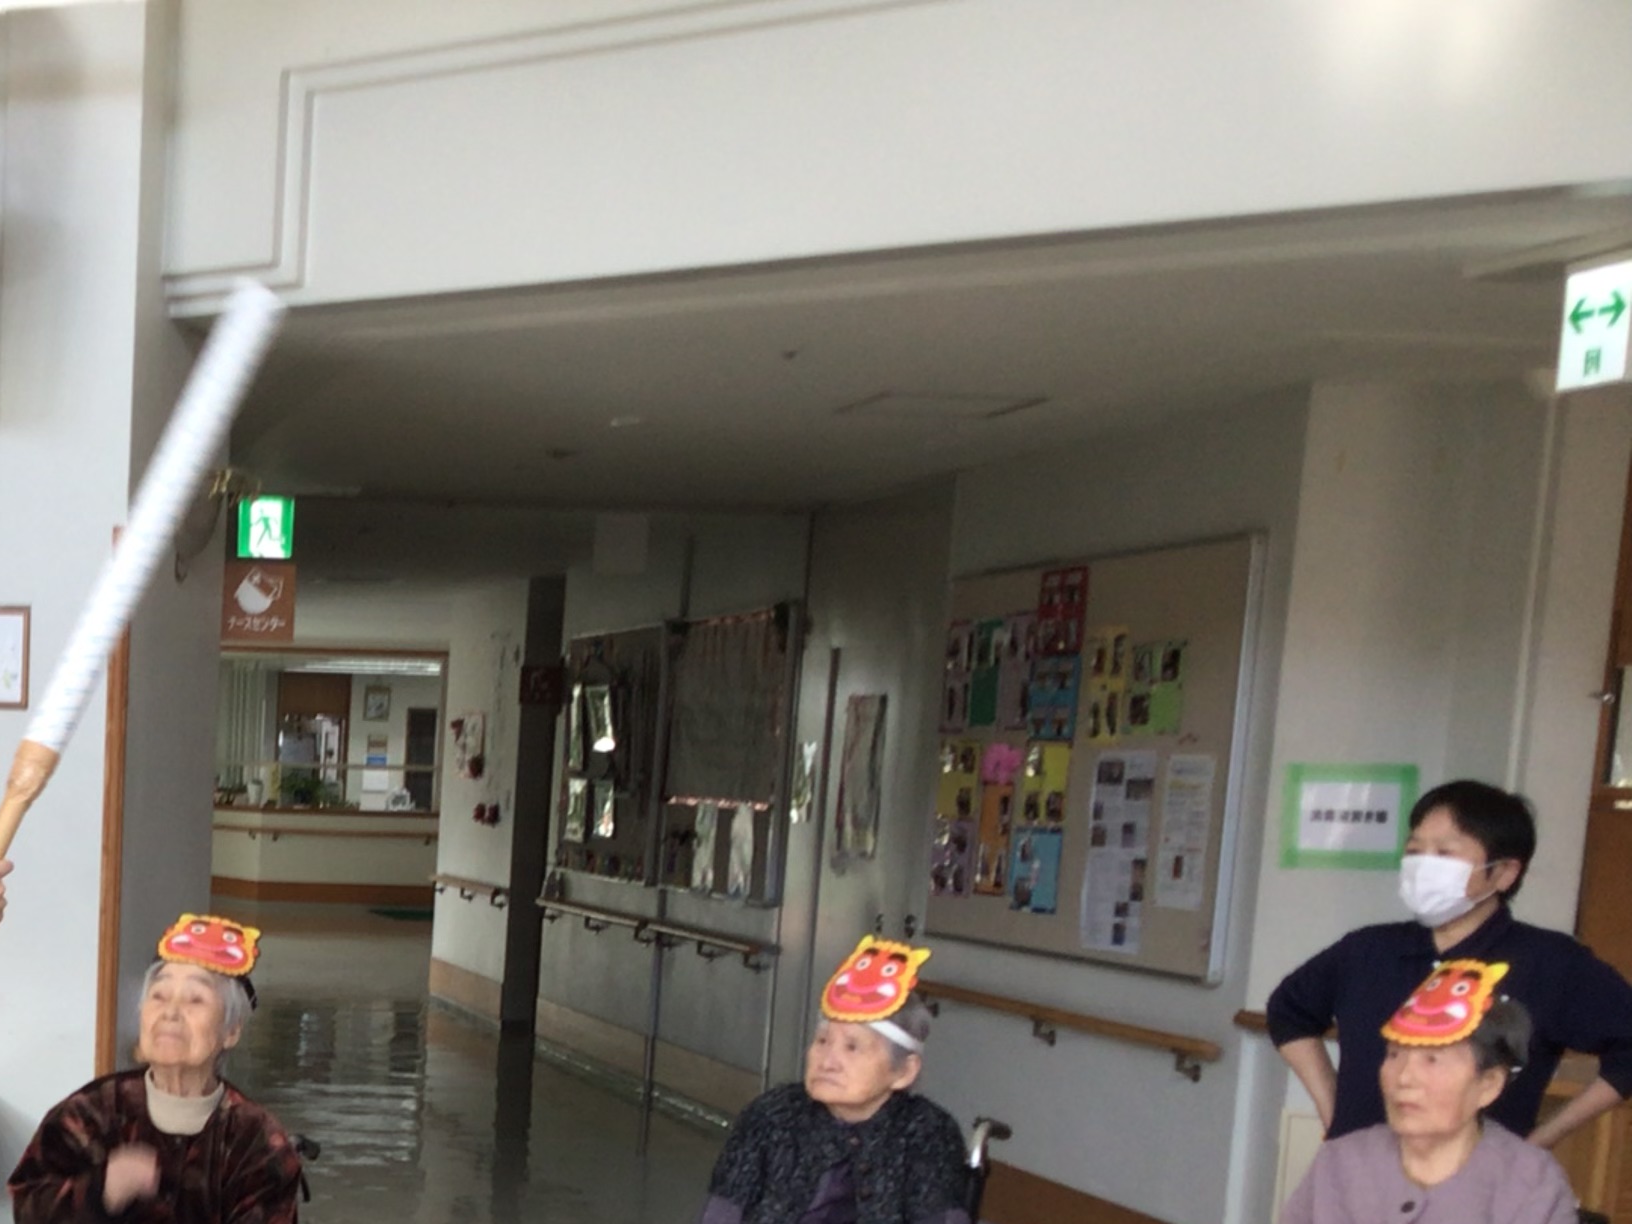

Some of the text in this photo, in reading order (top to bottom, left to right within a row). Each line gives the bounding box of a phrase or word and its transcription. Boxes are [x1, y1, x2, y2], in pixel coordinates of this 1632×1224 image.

[227, 615, 286, 632] ナースセンター
